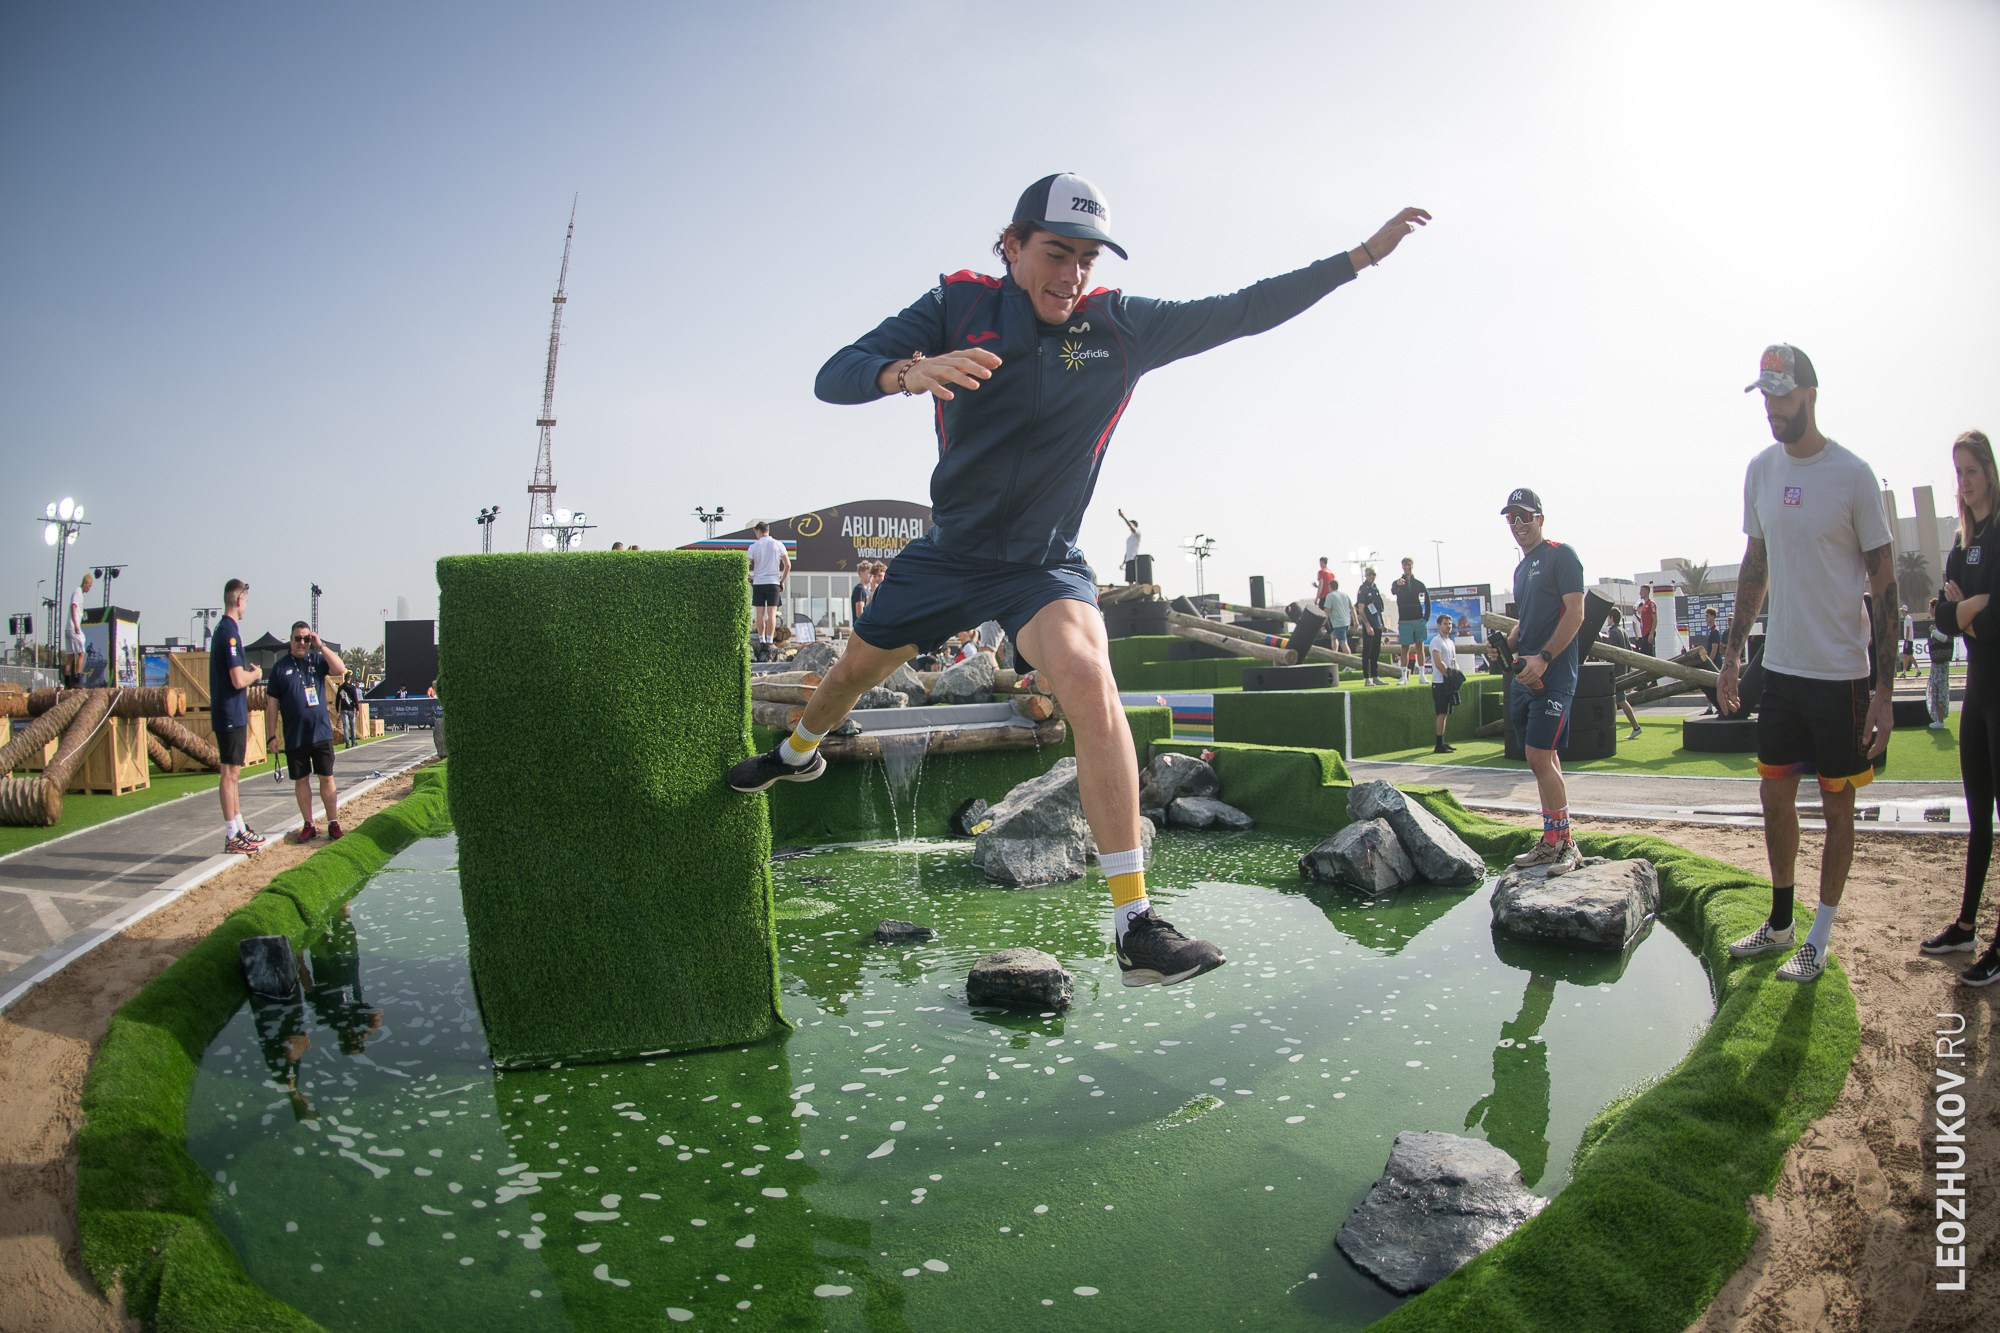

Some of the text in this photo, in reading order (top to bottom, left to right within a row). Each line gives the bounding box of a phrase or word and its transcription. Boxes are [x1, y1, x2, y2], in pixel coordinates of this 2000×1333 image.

[1071, 349, 1109, 360] Cofidis
[841, 516, 923, 539] ABU DHABI
[853, 536, 867, 549] UCI
[869, 537, 898, 549] URBAN
[857, 548, 883, 559] WORLD
